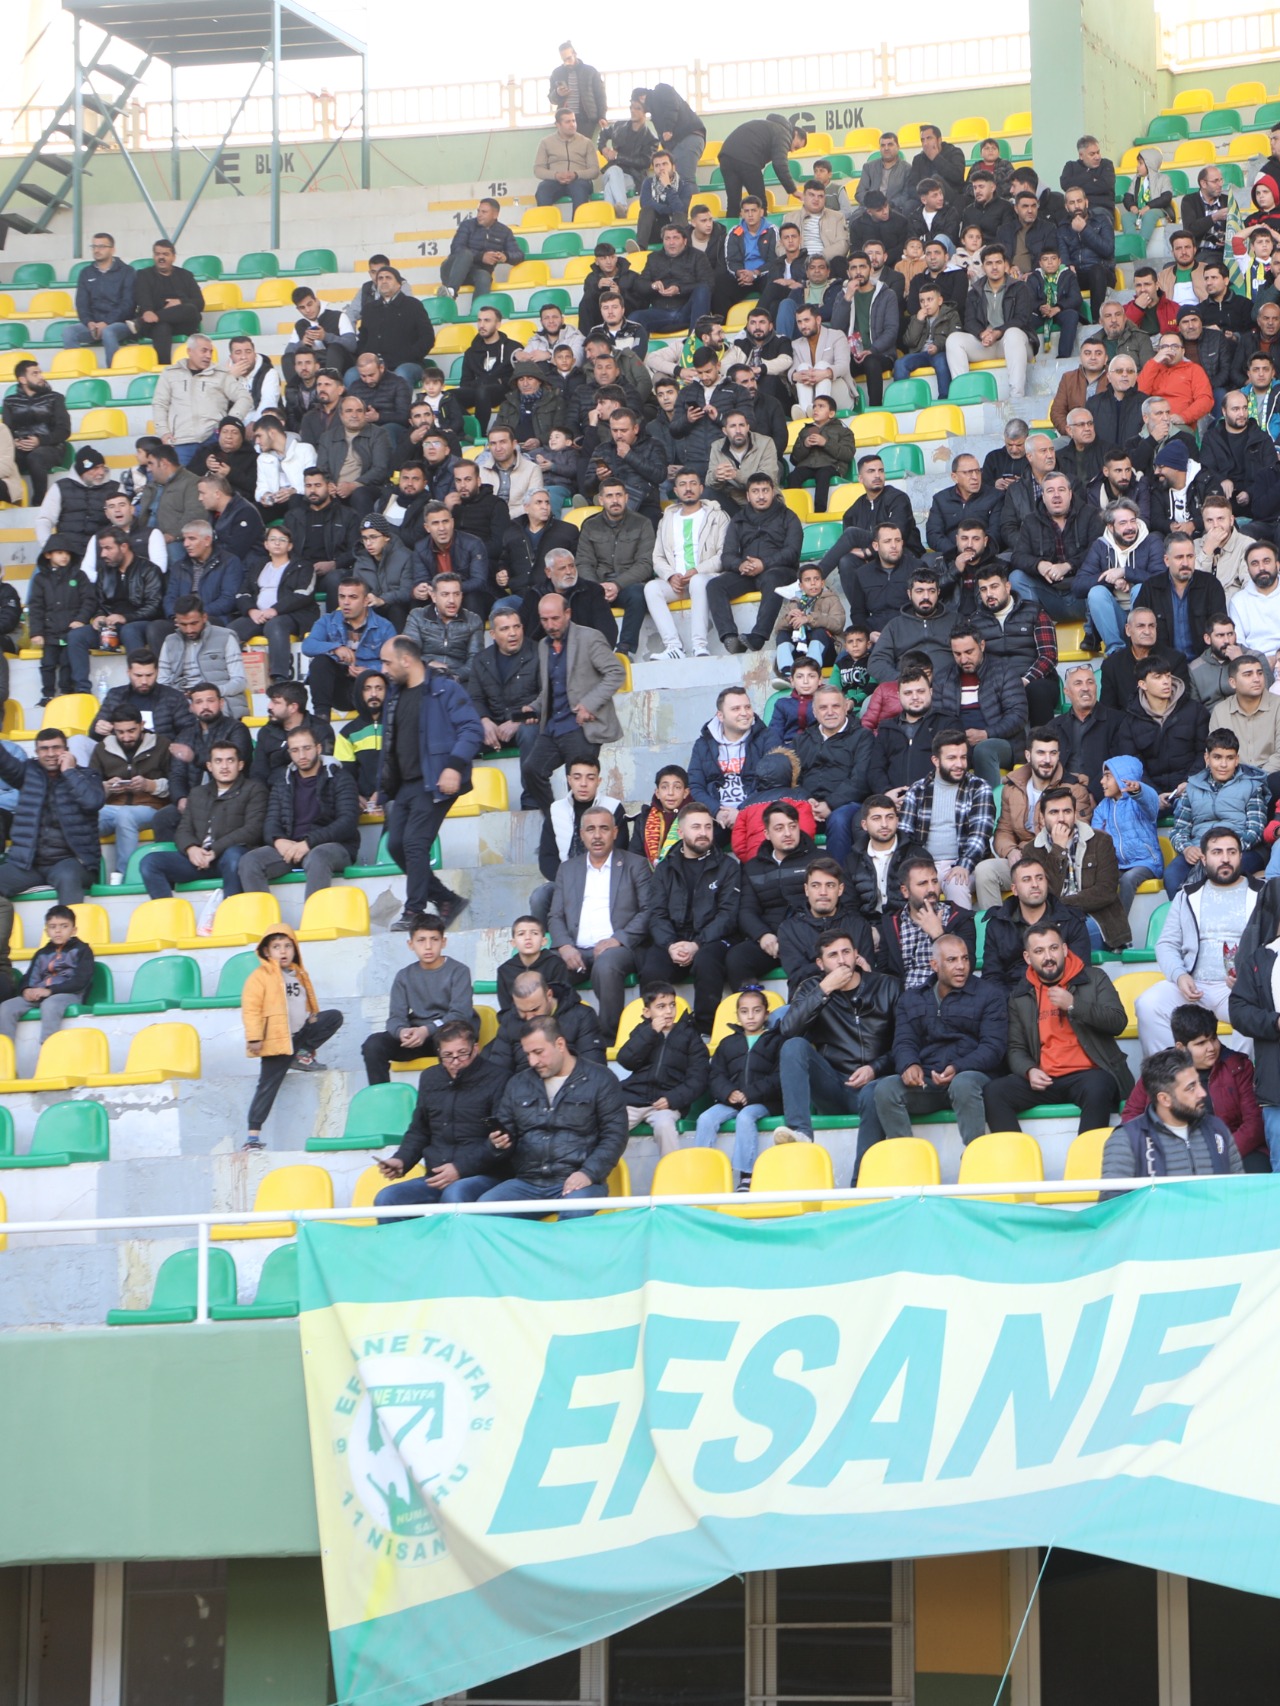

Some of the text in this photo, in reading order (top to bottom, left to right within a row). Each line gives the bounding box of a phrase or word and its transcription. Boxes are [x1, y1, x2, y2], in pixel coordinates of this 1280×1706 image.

[825, 107, 864, 130] BLOK
[215, 153, 240, 184] E
[488, 182, 507, 196] 15
[418, 241, 438, 256] 13
[422, 1336, 491, 1401] TAYFA
[395, 1387, 436, 1404] TAYFA
[488, 1284, 1240, 1534] EFSANE
